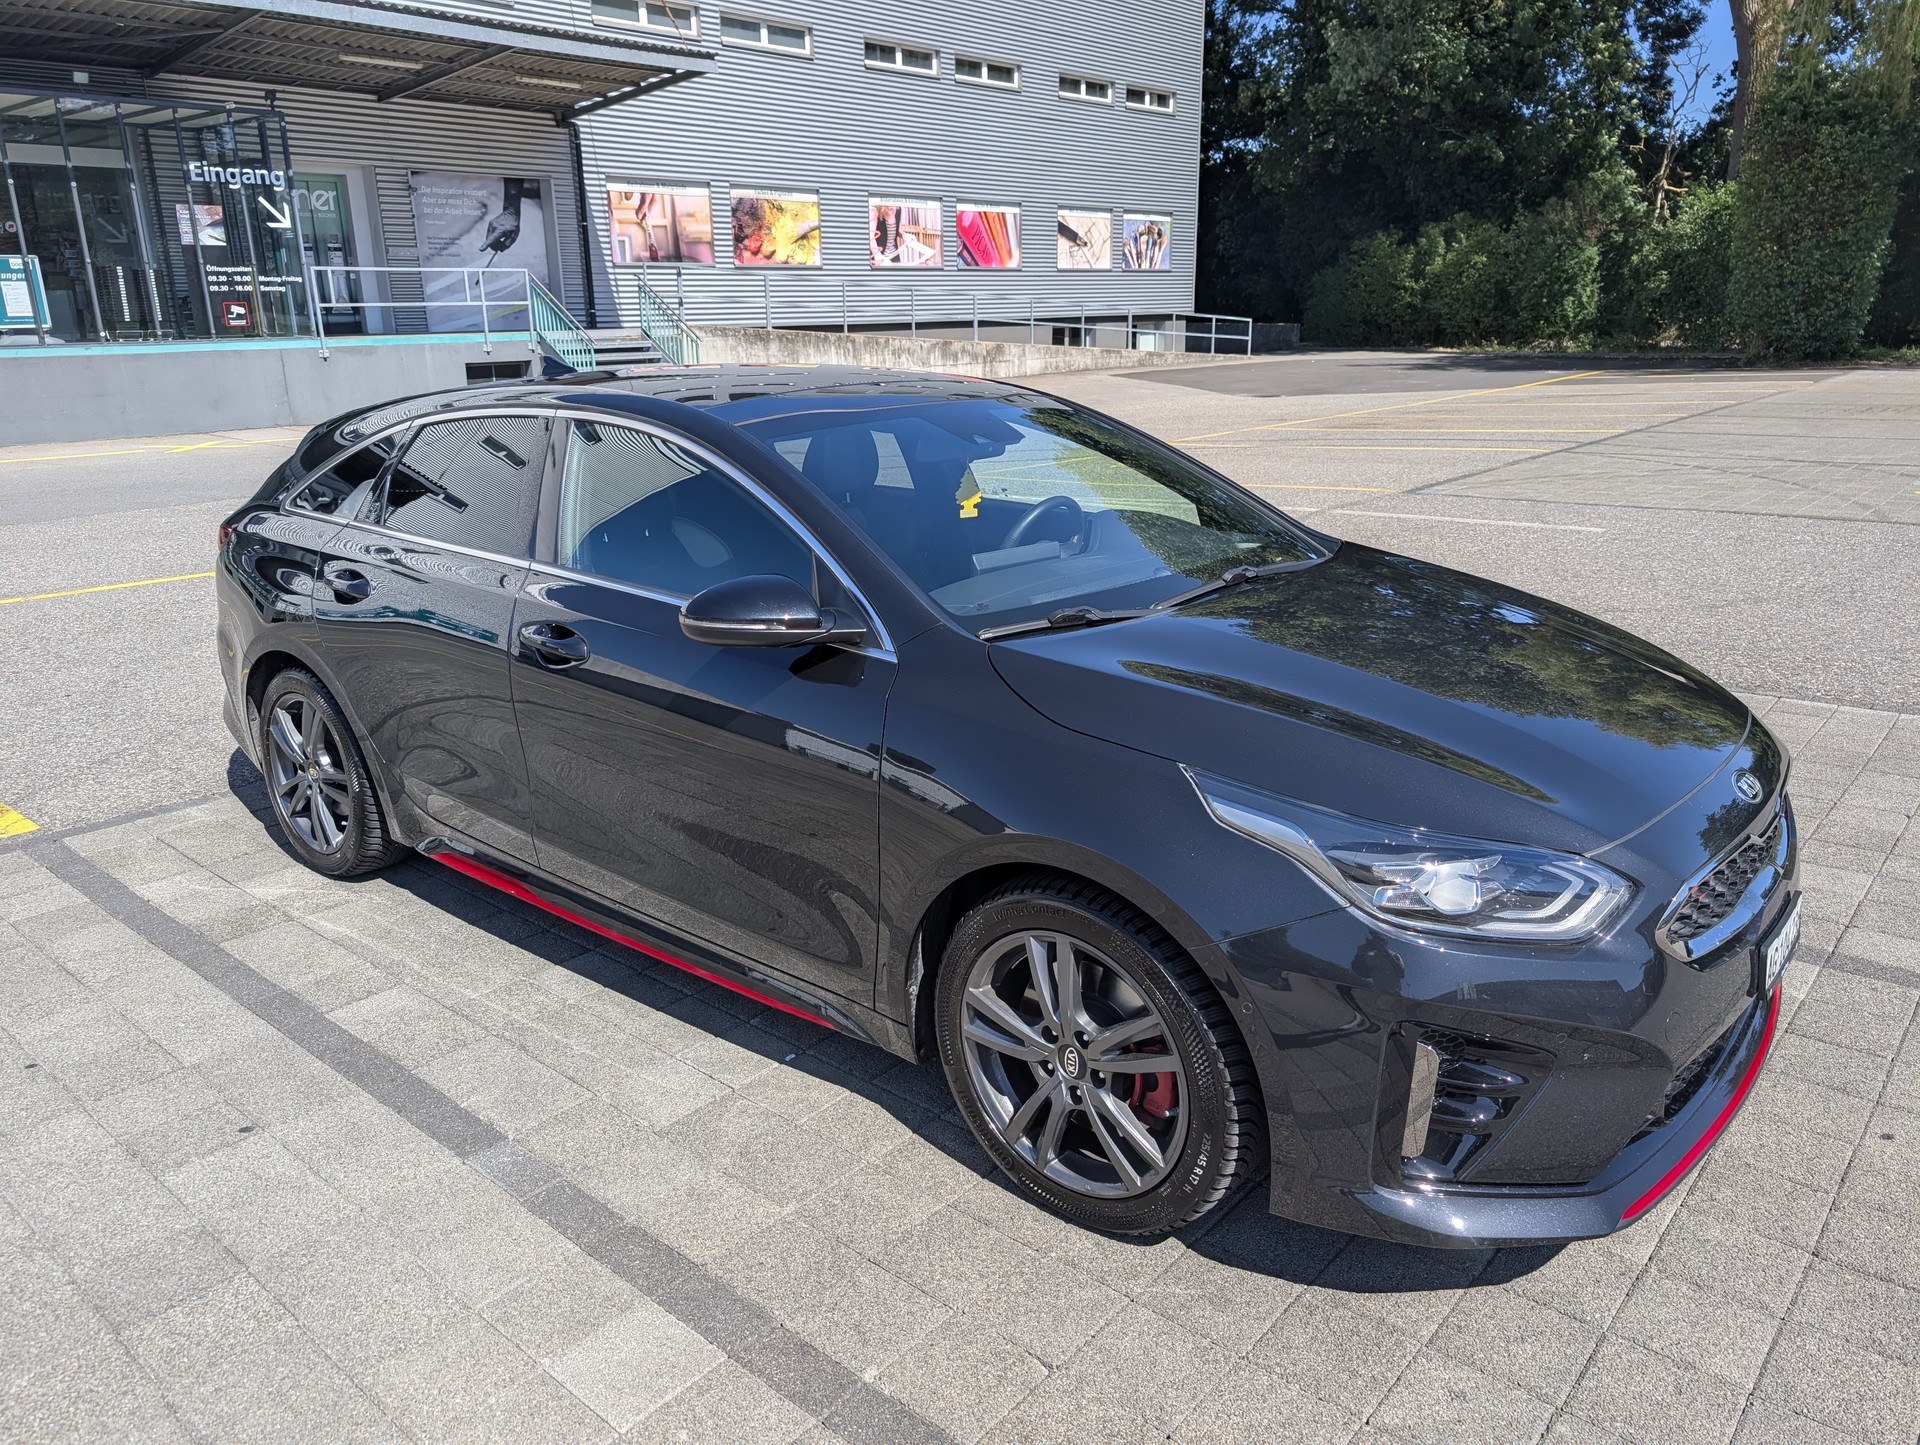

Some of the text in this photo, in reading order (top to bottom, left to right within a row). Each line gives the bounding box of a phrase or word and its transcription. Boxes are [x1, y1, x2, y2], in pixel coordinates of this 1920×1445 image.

[188, 161, 286, 192] Eingang
[422, 196, 437, 204] Aber
[423, 206, 434, 214] bei
[445, 207, 463, 216] Arbeit
[206, 264, 253, 273] Öffnungszeiten
[1182, 1131, 1212, 1194] 225/45 R 17 H
